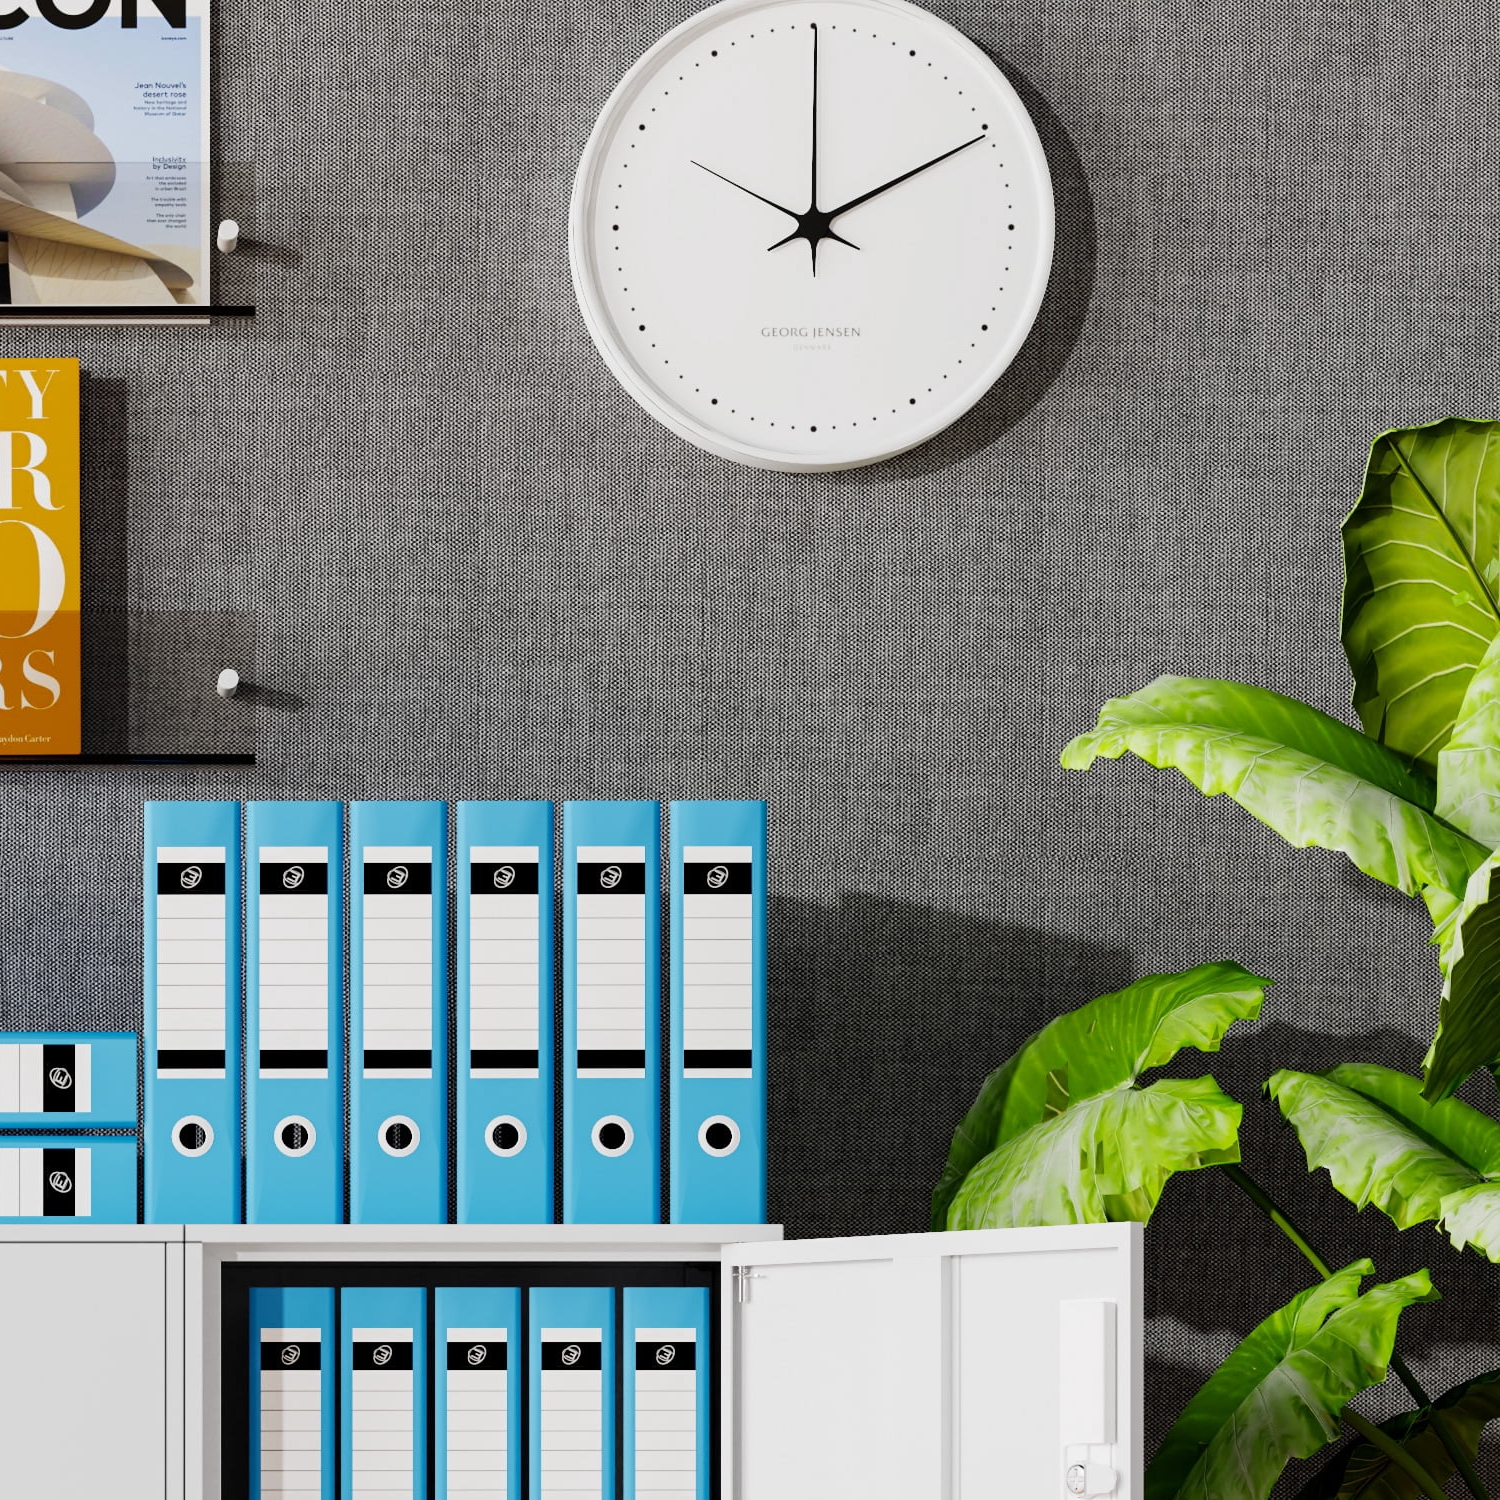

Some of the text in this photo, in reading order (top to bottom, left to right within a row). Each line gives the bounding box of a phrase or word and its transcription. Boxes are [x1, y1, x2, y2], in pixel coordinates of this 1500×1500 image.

[152, 163, 187, 171] by Design
[761, 327, 861, 338] GEORG JENSEN
[24, 734, 52, 743] Carter
